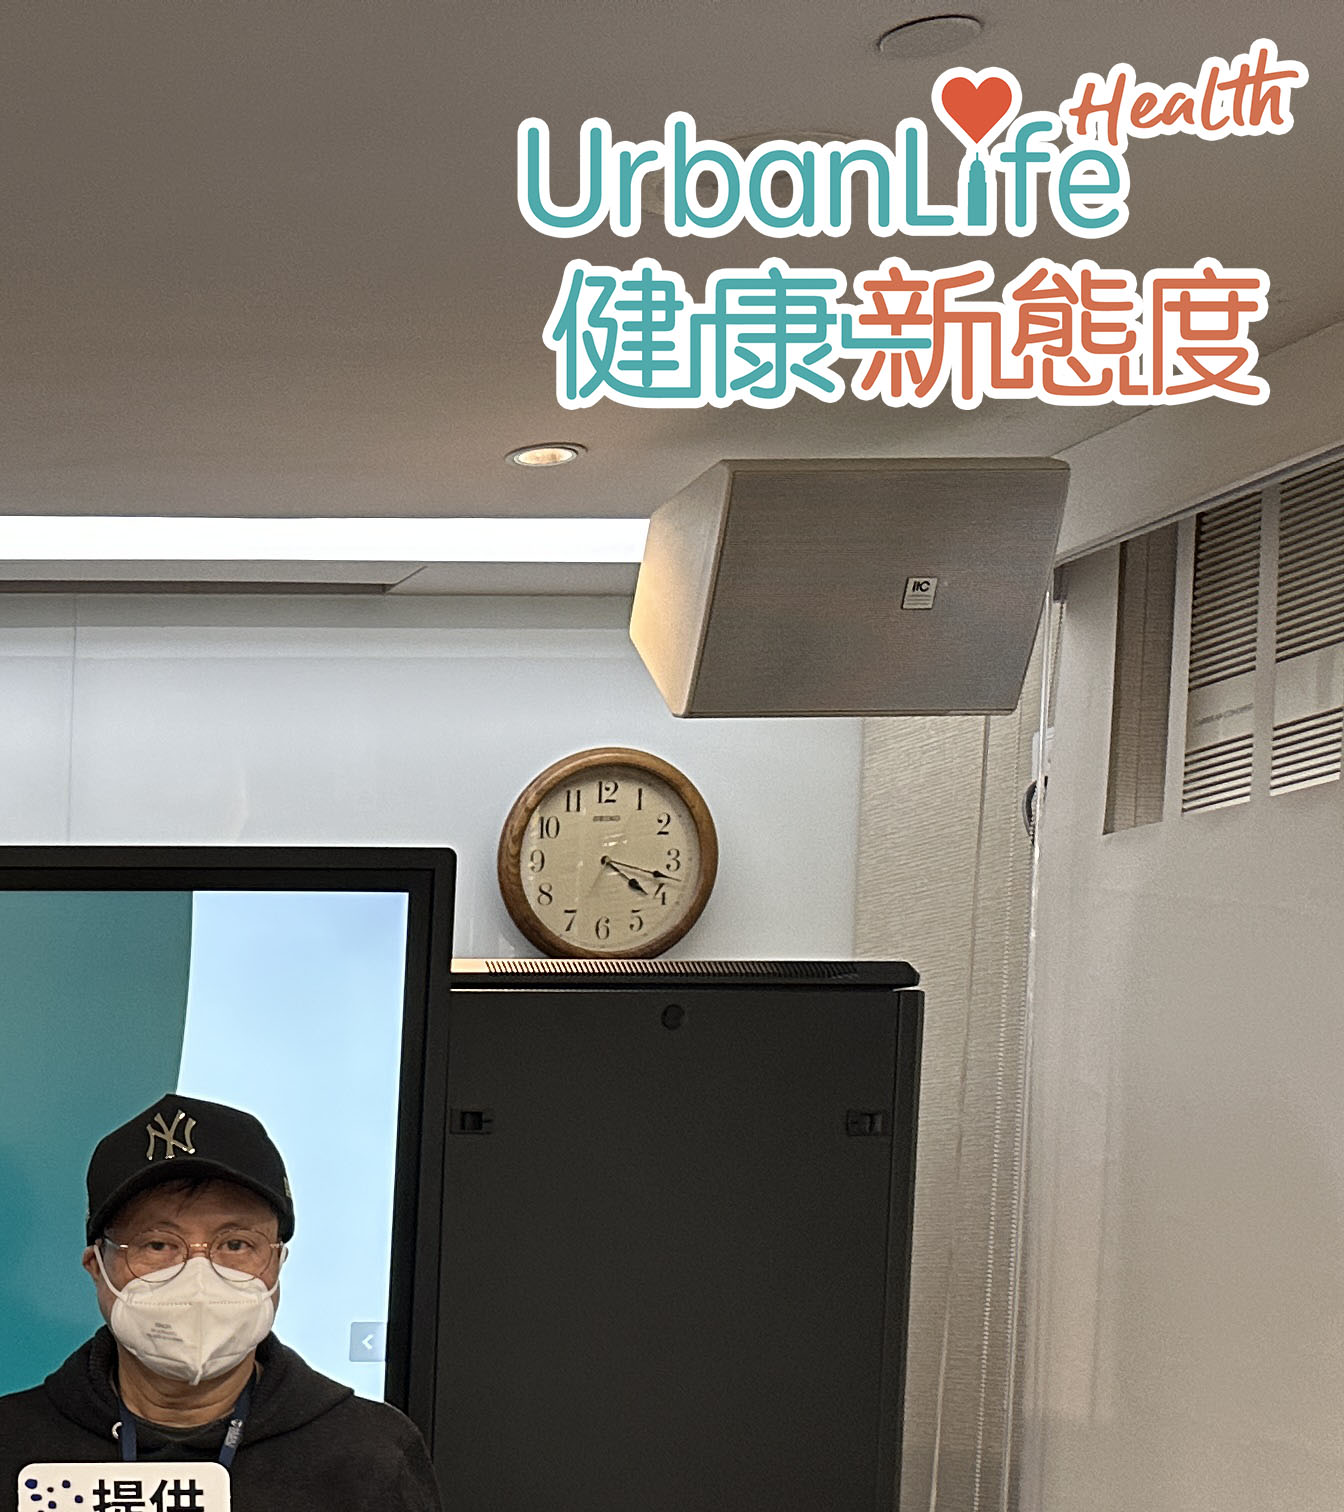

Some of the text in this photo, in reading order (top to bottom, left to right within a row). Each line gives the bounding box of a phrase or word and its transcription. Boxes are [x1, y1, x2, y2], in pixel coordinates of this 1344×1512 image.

[566, 790, 580, 811] 11
[598, 782, 618, 803] 12
[637, 789, 643, 810] 1
[539, 817, 559, 838] 10
[657, 814, 670, 835] 2
[530, 851, 545, 872] 9
[666, 849, 680, 871] 3
[538, 883, 552, 905] 8
[654, 883, 667, 905] 4
[564, 909, 577, 931] 7
[596, 917, 609, 939] 6
[630, 909, 643, 931] 5
[146, 1109, 197, 1160] NY
